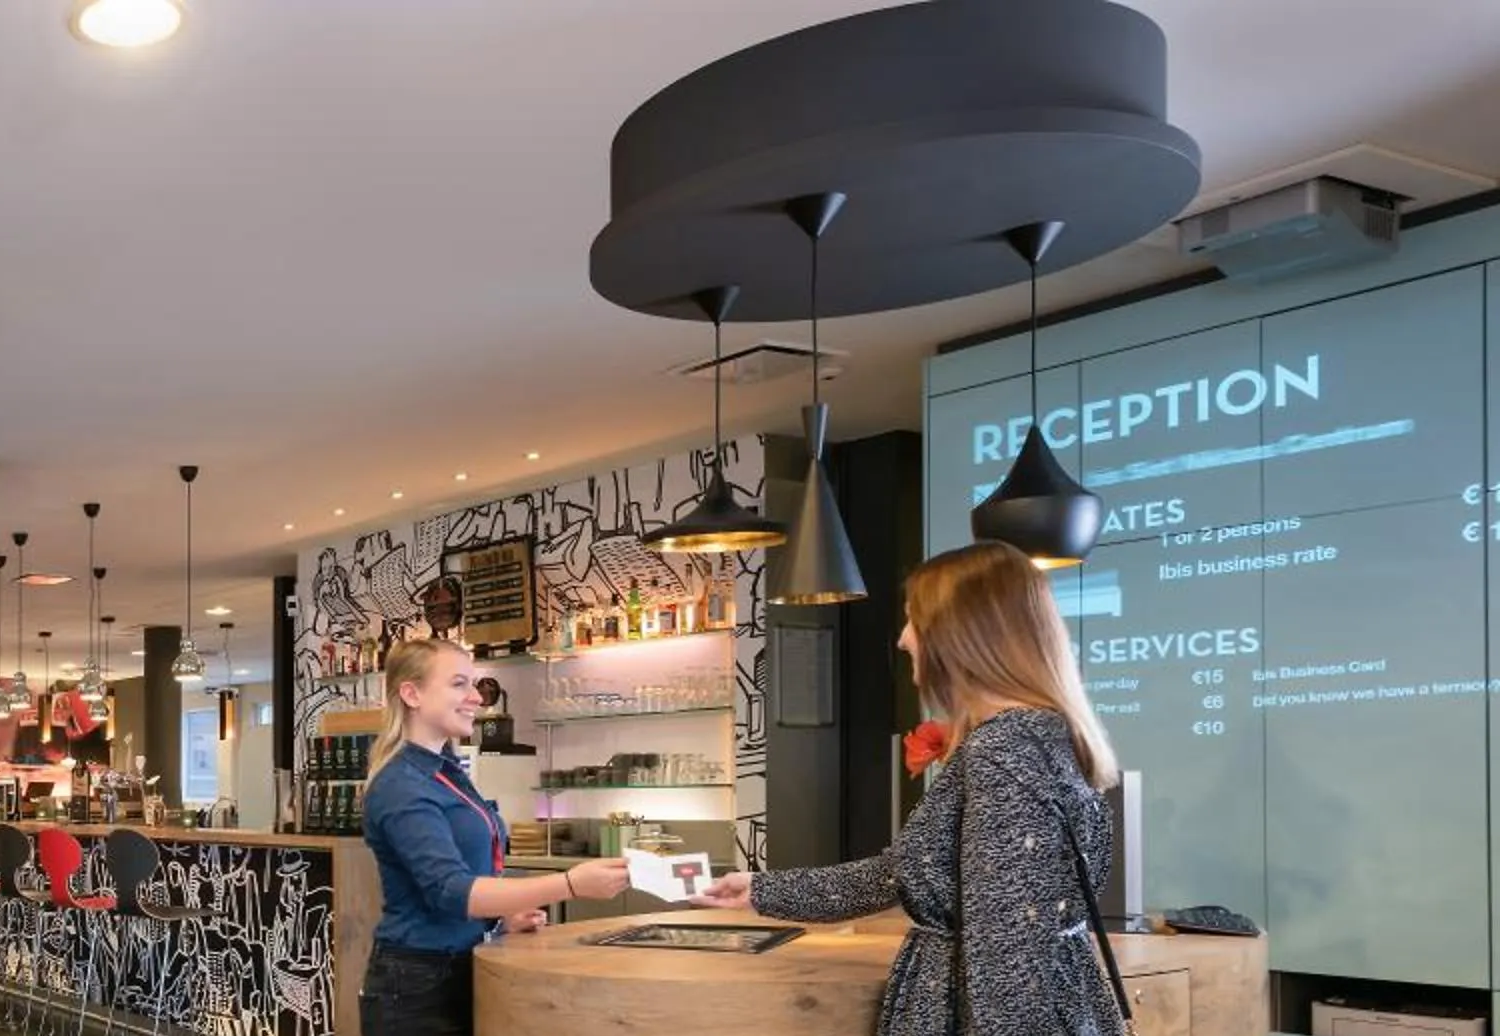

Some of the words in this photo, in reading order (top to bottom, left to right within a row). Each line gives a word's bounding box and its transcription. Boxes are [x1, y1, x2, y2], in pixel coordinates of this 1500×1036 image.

[973, 355, 1319, 465] RECEPTION
[1102, 499, 1185, 535] ATES
[1175, 532, 1195, 545] or
[1200, 526, 1213, 542] 2
[1217, 516, 1302, 543] persons
[1159, 563, 1193, 581] Ibis
[1198, 551, 1288, 575] business
[1293, 545, 1337, 565] rate
[1089, 627, 1260, 663] SERVICES
[1192, 668, 1224, 685] €15
[1280, 664, 1345, 680] Business
[1349, 659, 1386, 674] Card
[1280, 692, 1305, 707] you
[1309, 688, 1349, 704] know
[1352, 687, 1375, 700] we
[1378, 682, 1415, 698] have
[1193, 720, 1225, 736] €10
